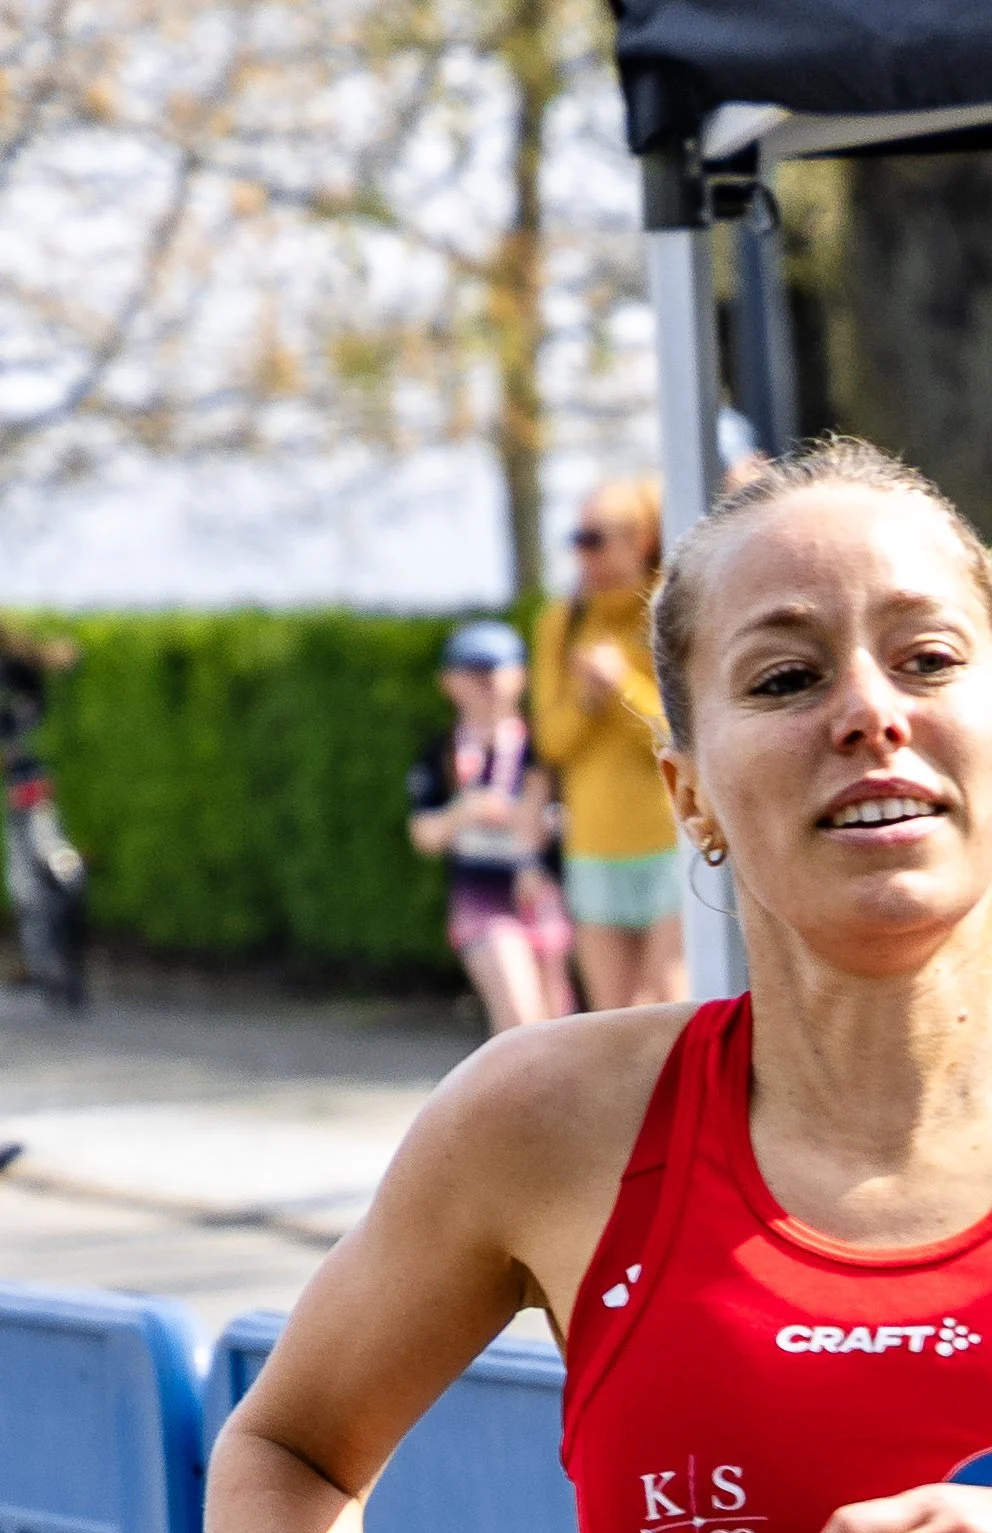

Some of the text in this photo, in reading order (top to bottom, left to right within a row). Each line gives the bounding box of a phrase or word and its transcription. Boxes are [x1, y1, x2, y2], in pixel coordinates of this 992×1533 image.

[775, 1324, 936, 1354] CRAFT
[640, 1464, 746, 1521] K S
